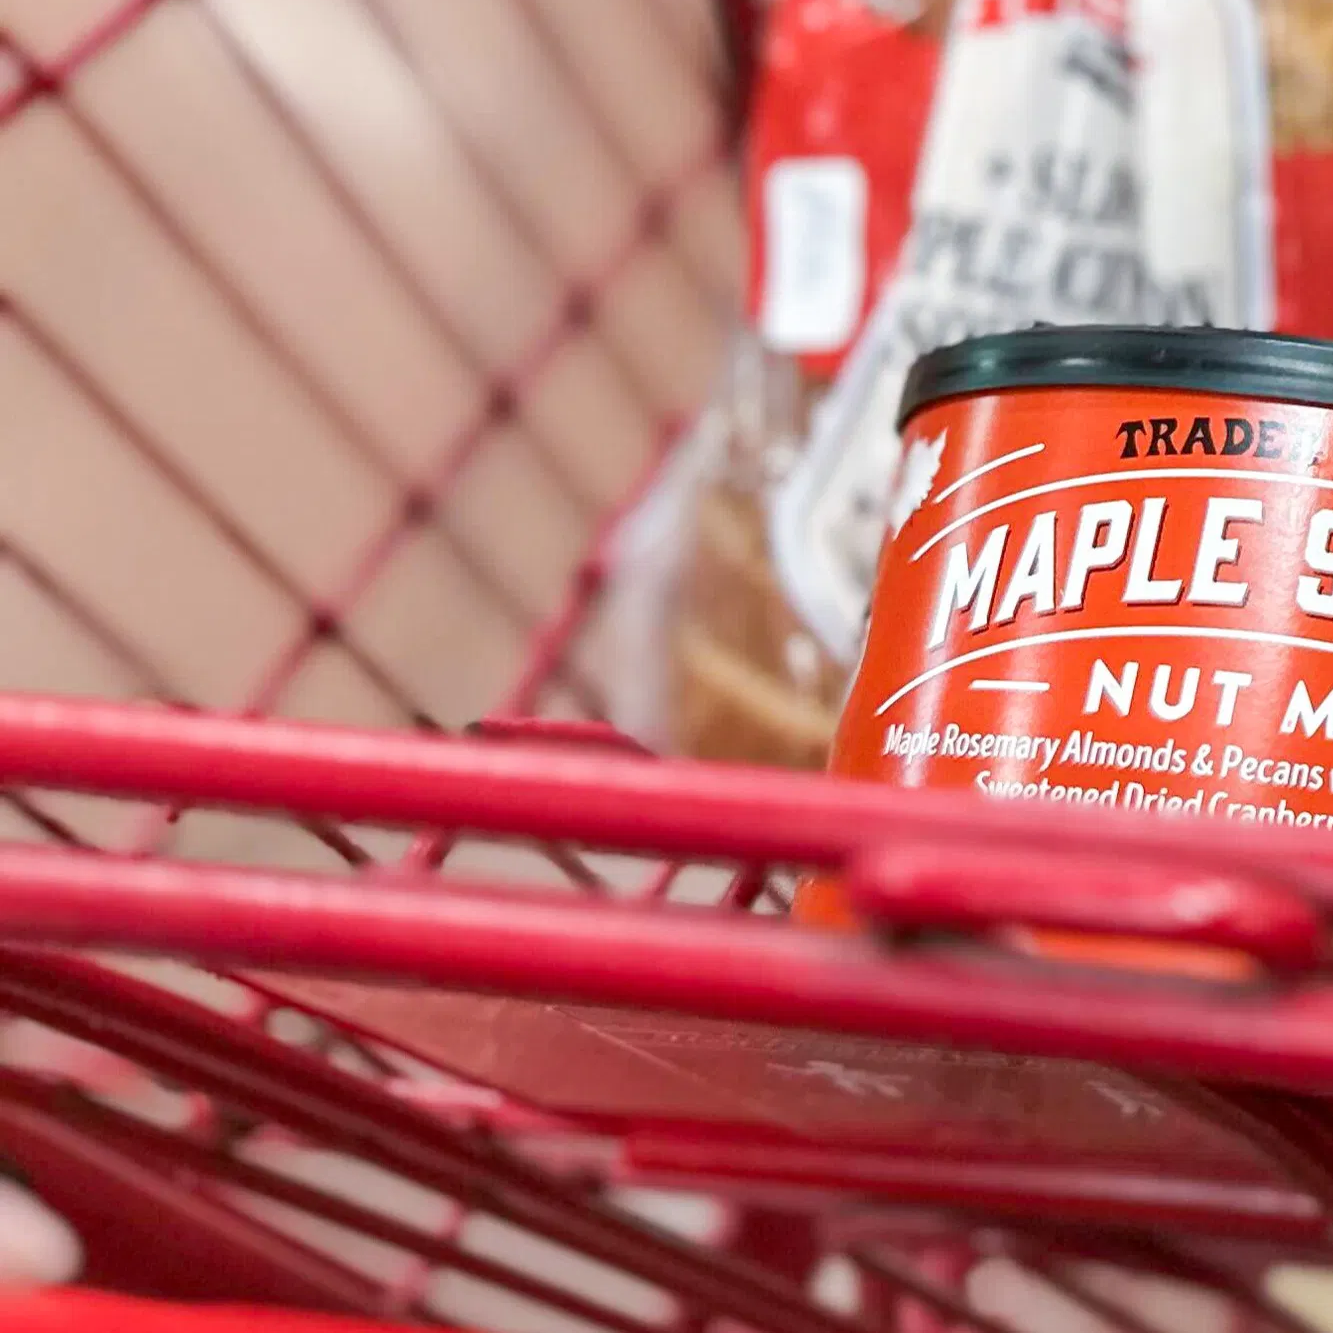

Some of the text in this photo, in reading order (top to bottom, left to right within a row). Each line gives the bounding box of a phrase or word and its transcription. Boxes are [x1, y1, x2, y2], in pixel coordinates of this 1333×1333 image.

[1115, 416, 1320, 468] TRADE
[927, 496, 1265, 652] MAPLE
[1082, 659, 1253, 727] NUT
[883, 723, 939, 765] Maple
[940, 722, 1061, 774] Rosemary
[1060, 729, 1187, 773] Almonds
[1190, 743, 1214, 777] &
[1219, 743, 1325, 791] Pecans
